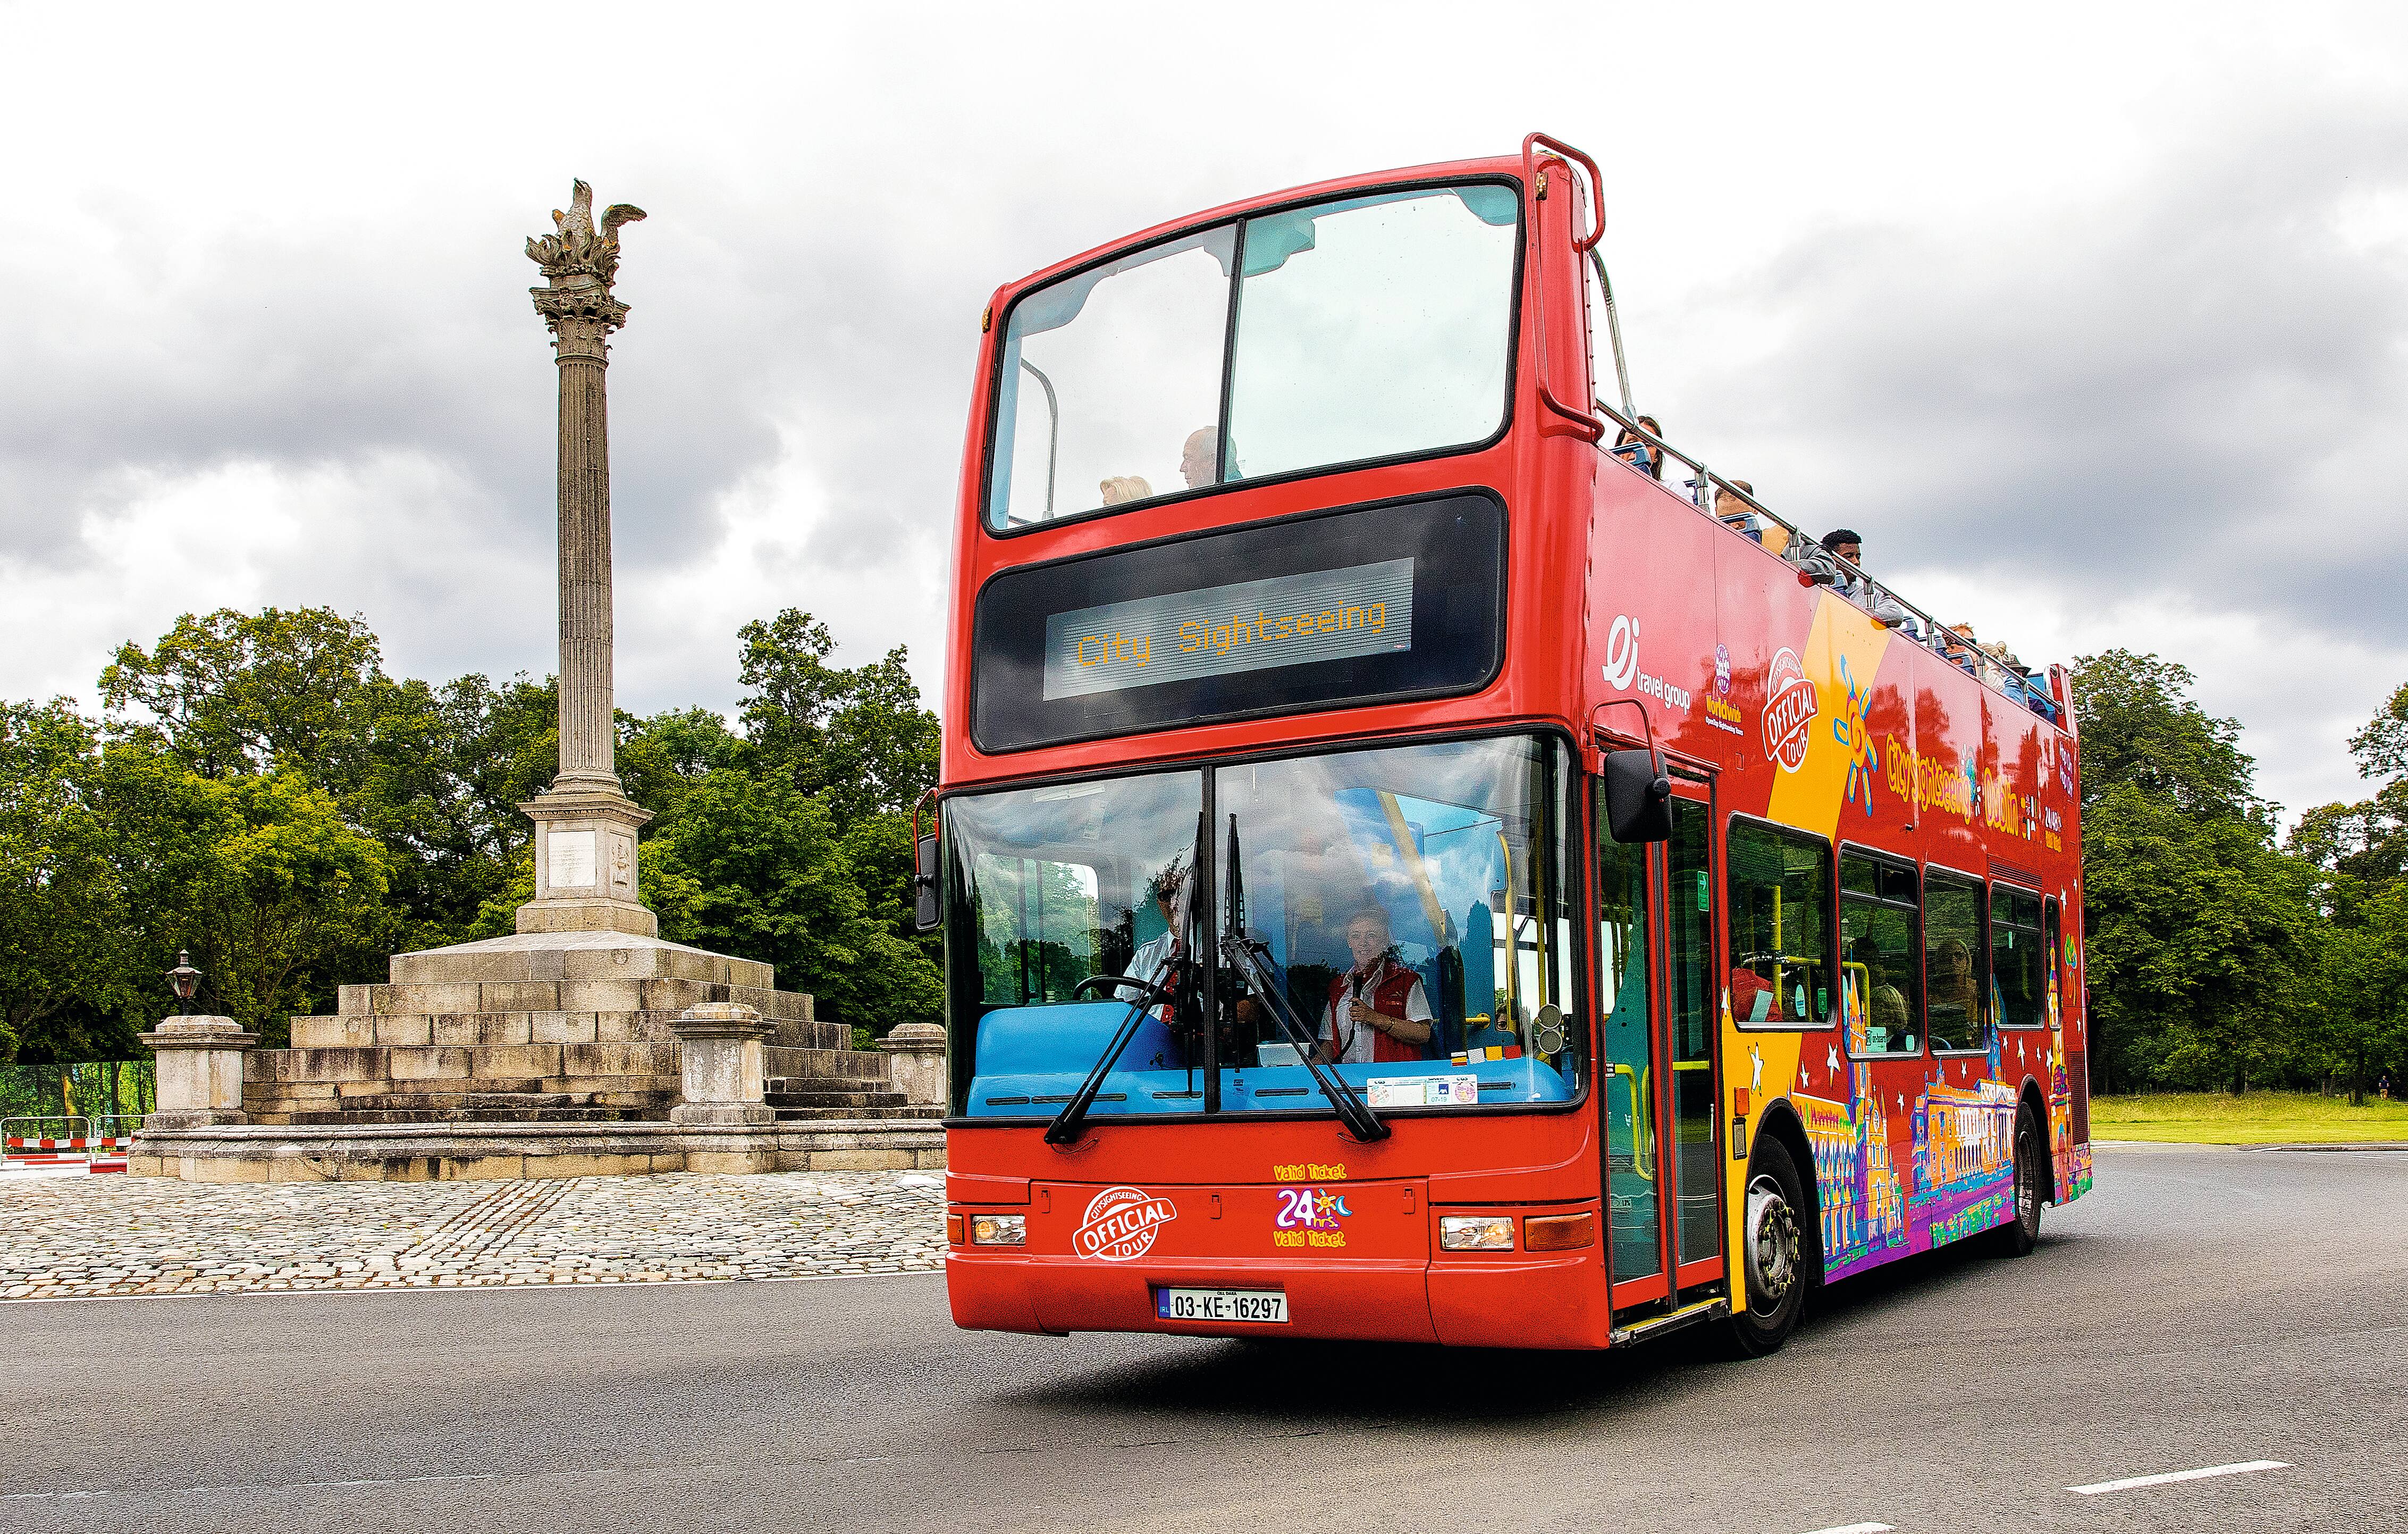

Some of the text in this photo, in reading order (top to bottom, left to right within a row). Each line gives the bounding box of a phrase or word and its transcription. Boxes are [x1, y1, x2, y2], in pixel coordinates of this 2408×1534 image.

[1079, 600, 1385, 667] City Sightseeing
[1637, 665, 1690, 715] travel group
[1771, 656, 1800, 693] CITYSIGHTSEEING
[1767, 686, 1816, 746] OFFICIAL
[1786, 729, 1807, 763] TOUR
[1274, 1163, 1348, 1181] Valid Ticket
[1090, 1192, 1142, 1220] CITYSIGHTSEEING
[1277, 1189, 1316, 1227] 24
[1083, 1202, 1171, 1251] OFFICIAL
[1114, 1231, 1152, 1256] TOUR
[1273, 1230, 1346, 1248] Valid Ticket
[1175, 1296, 1282, 1319] 03-KE-16297
